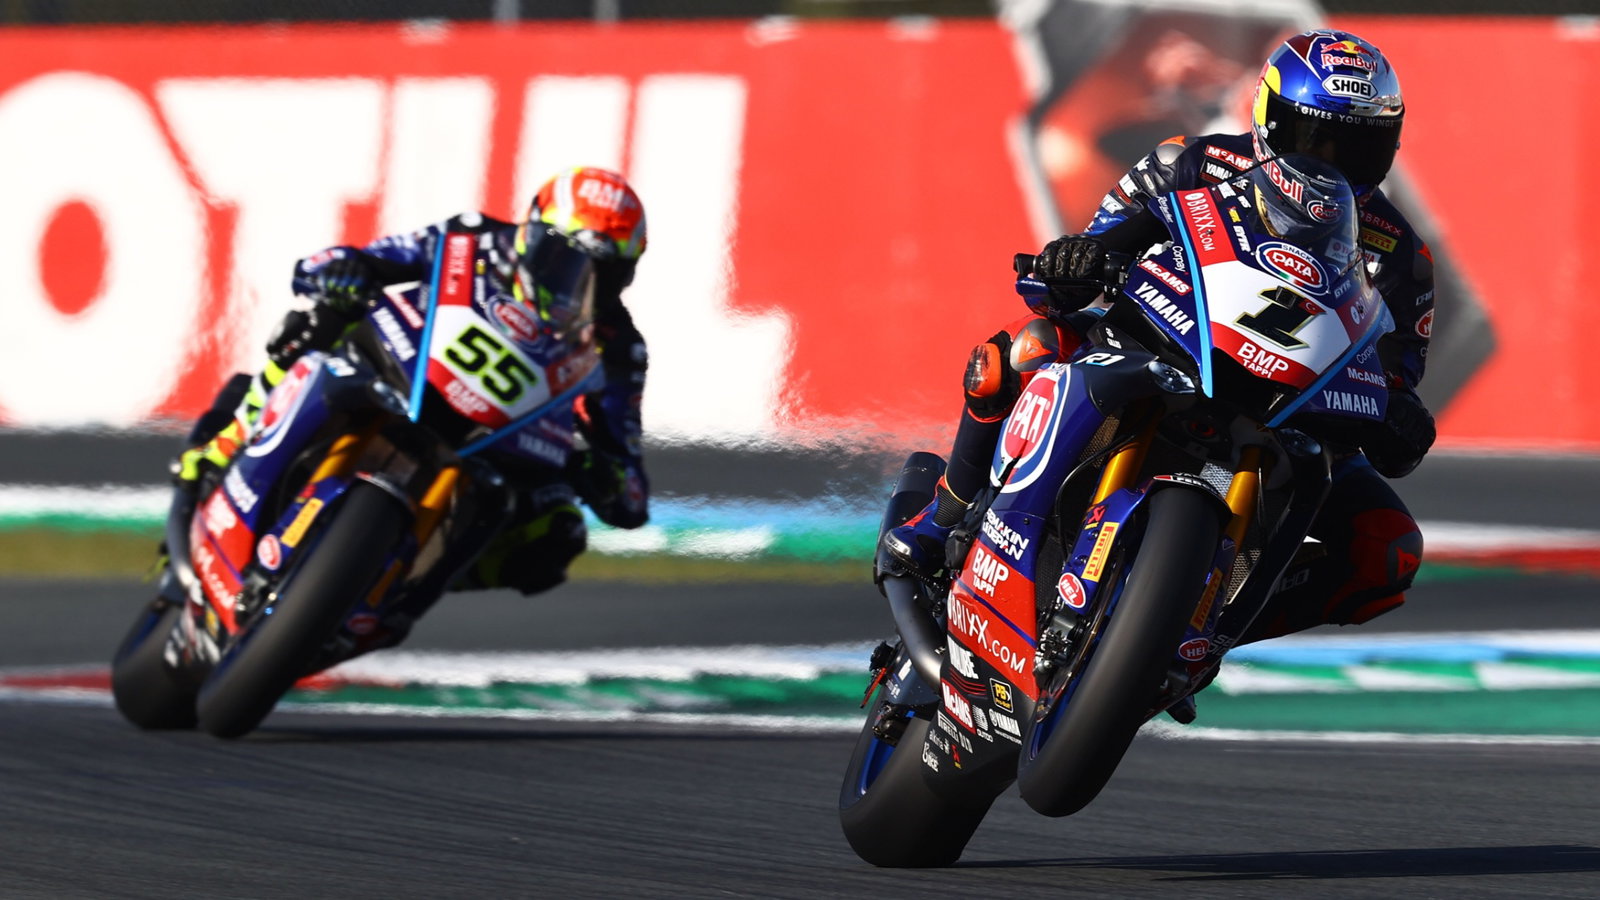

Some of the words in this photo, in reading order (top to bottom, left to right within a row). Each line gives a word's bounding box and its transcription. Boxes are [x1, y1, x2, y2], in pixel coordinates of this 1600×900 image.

[1321, 53, 1353, 67] Red
[1352, 57, 1378, 73] Bull
[1332, 79, 1372, 97] SHOEI
[1301, 105, 1333, 120] GIVES
[1339, 114, 1361, 125] YOU
[1367, 118, 1395, 128] WINGS
[1268, 160, 1303, 204] Bull
[1140, 259, 1190, 294] McAMS
[1272, 252, 1316, 283] PATA
[1134, 281, 1196, 336] YAMAHA
[1233, 284, 1322, 351] 1
[445, 324, 540, 406] 55
[1236, 341, 1290, 373] BMP
[1242, 358, 1273, 379] TAPPI
[1347, 367, 1387, 388] McAMS
[1322, 389, 1380, 416] YAMAHA
[972, 547, 1009, 586] BMP
[973, 575, 995, 598] TAPPI
[1061, 578, 1079, 604] HEL
